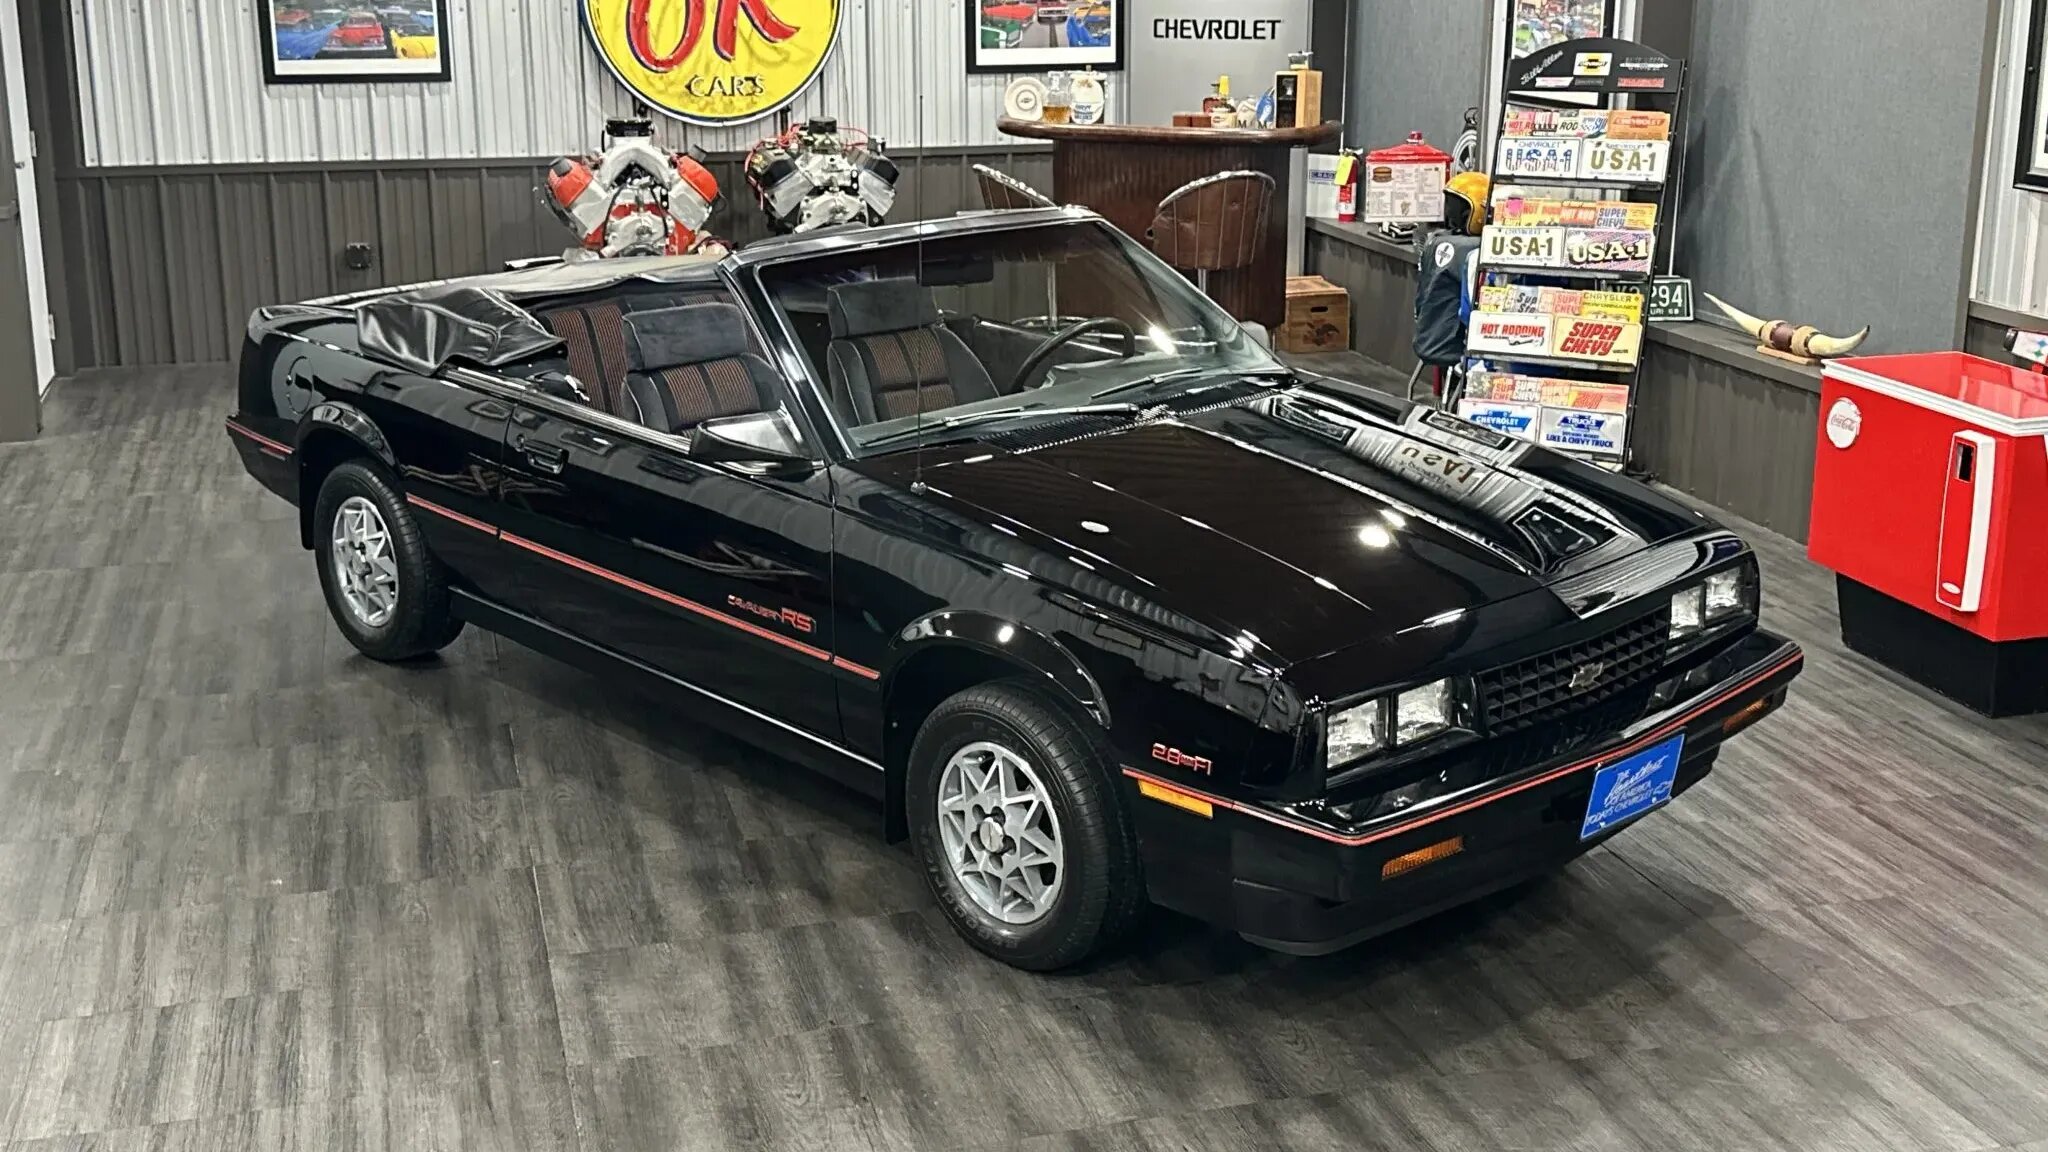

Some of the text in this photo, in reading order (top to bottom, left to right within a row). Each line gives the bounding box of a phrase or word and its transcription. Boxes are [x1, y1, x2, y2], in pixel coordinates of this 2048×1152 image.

[1153, 18, 1281, 40] CHEVROLET
[686, 74, 765, 97] CARS
[1599, 207, 1627, 217] SUPER
[1597, 217, 1625, 228] CHEVY
[1583, 292, 1632, 302] CHRYSLER
[1481, 323, 1546, 337] HOT RODDING
[1569, 322, 1623, 341] SUPER
[1560, 336, 1614, 356] CHEVY
[1476, 415, 1519, 426] CHEVROLET
[1546, 433, 1561, 442] LIKE
[1568, 436, 1590, 445] CHEVY
[1591, 438, 1614, 448] TRUCK
[781, 607, 812, 633] RS
